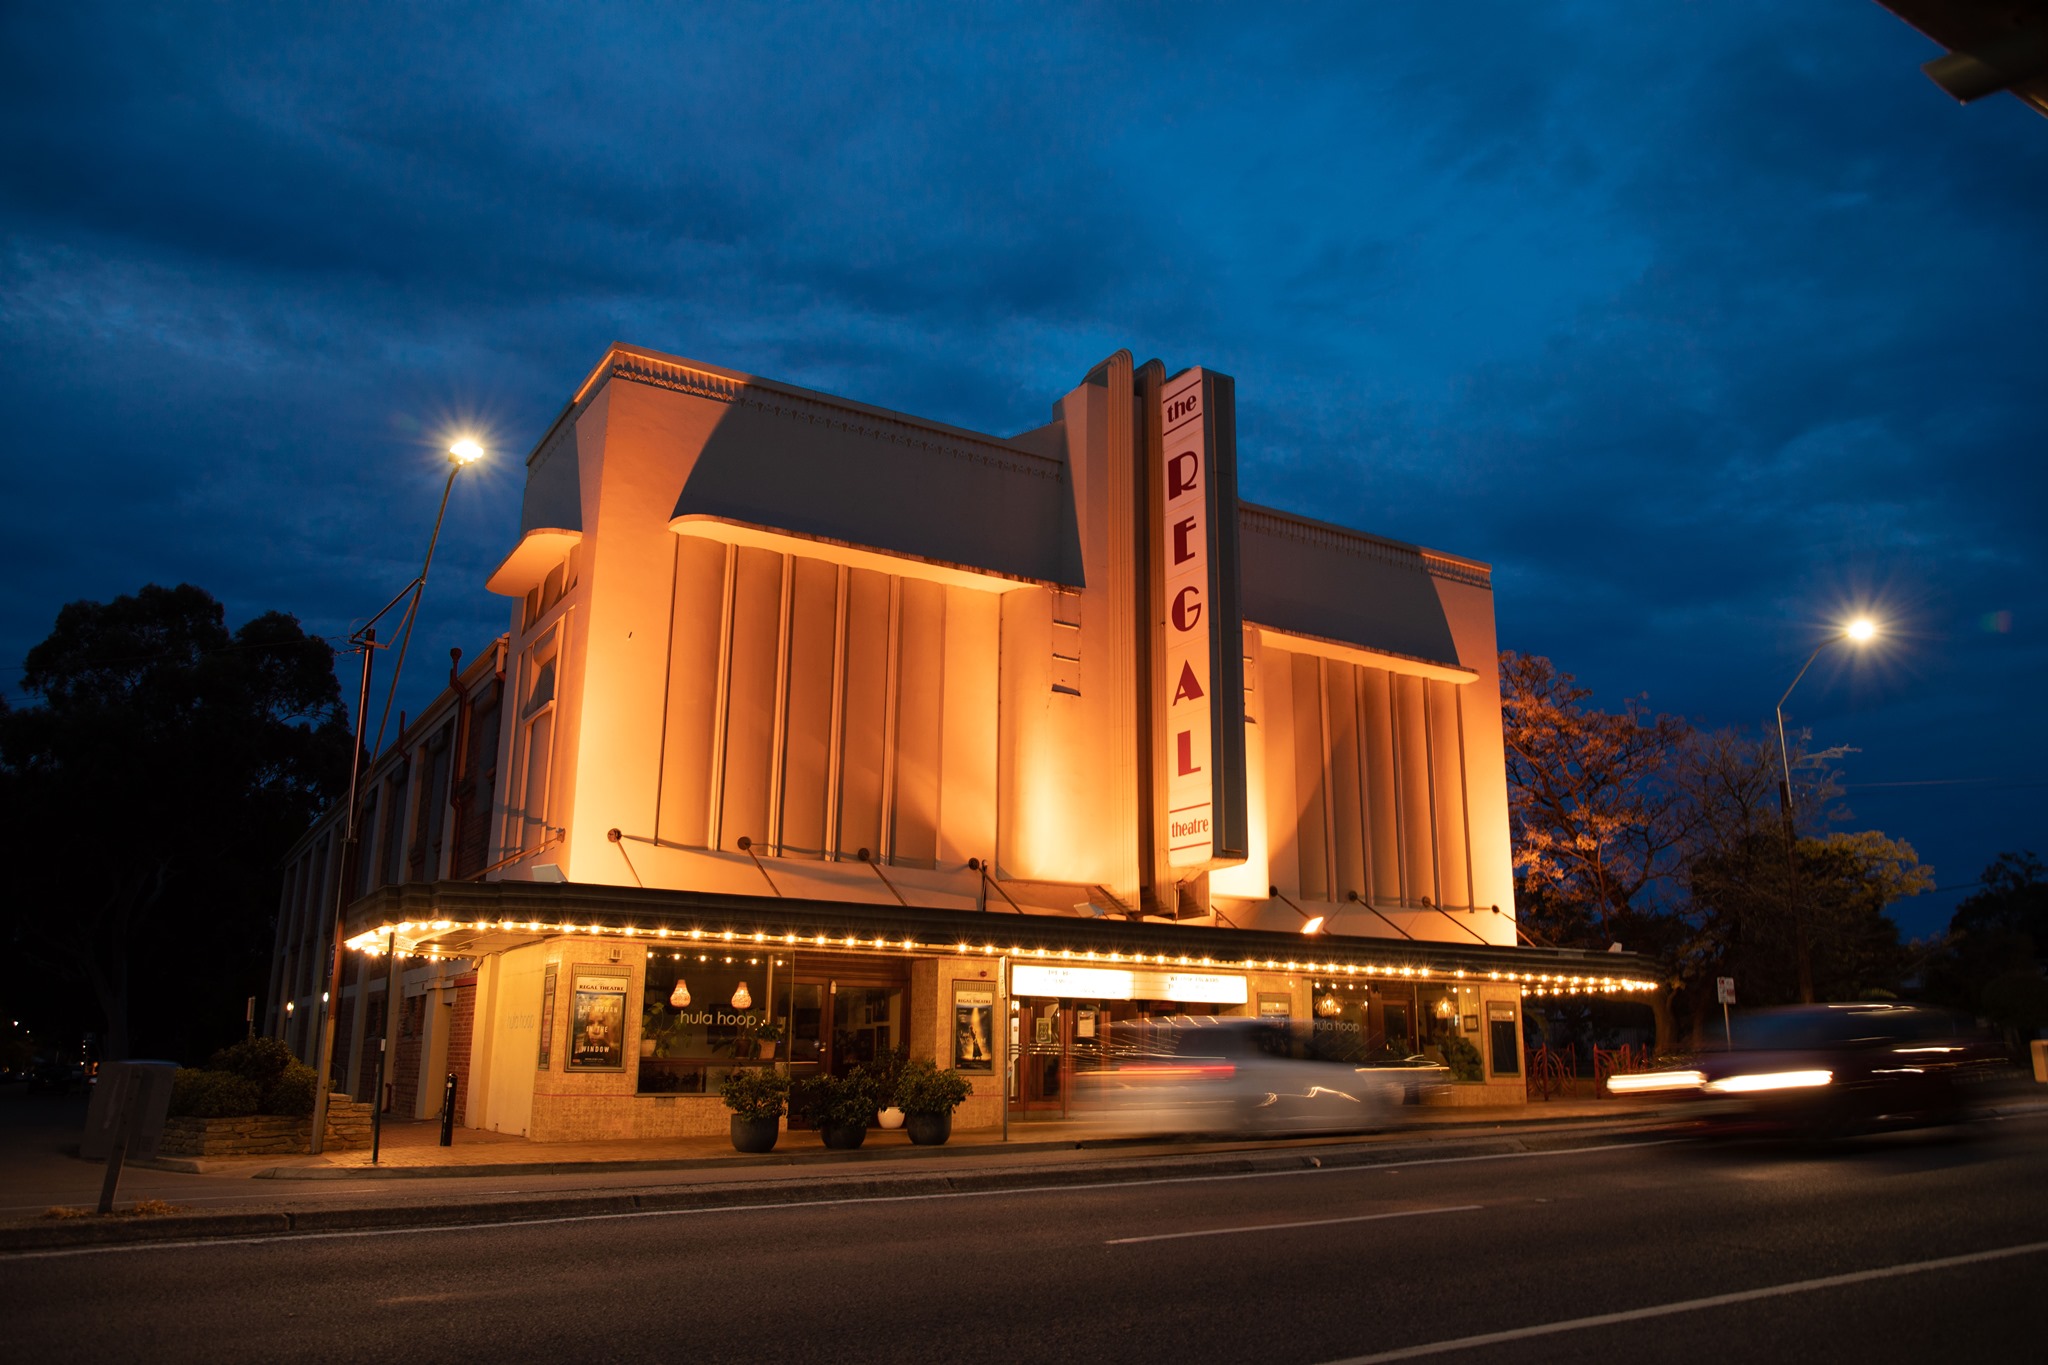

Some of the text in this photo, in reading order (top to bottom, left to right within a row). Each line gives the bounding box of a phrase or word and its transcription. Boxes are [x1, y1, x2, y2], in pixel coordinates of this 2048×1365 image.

[1167, 395, 1197, 423] the
[1168, 451, 1204, 777] REGAL
[1171, 818, 1209, 838] theatre
[680, 1010, 757, 1028] hula hoop
[1335, 1020, 1360, 1034] hoop
[581, 1045, 610, 1053] WINDOW
